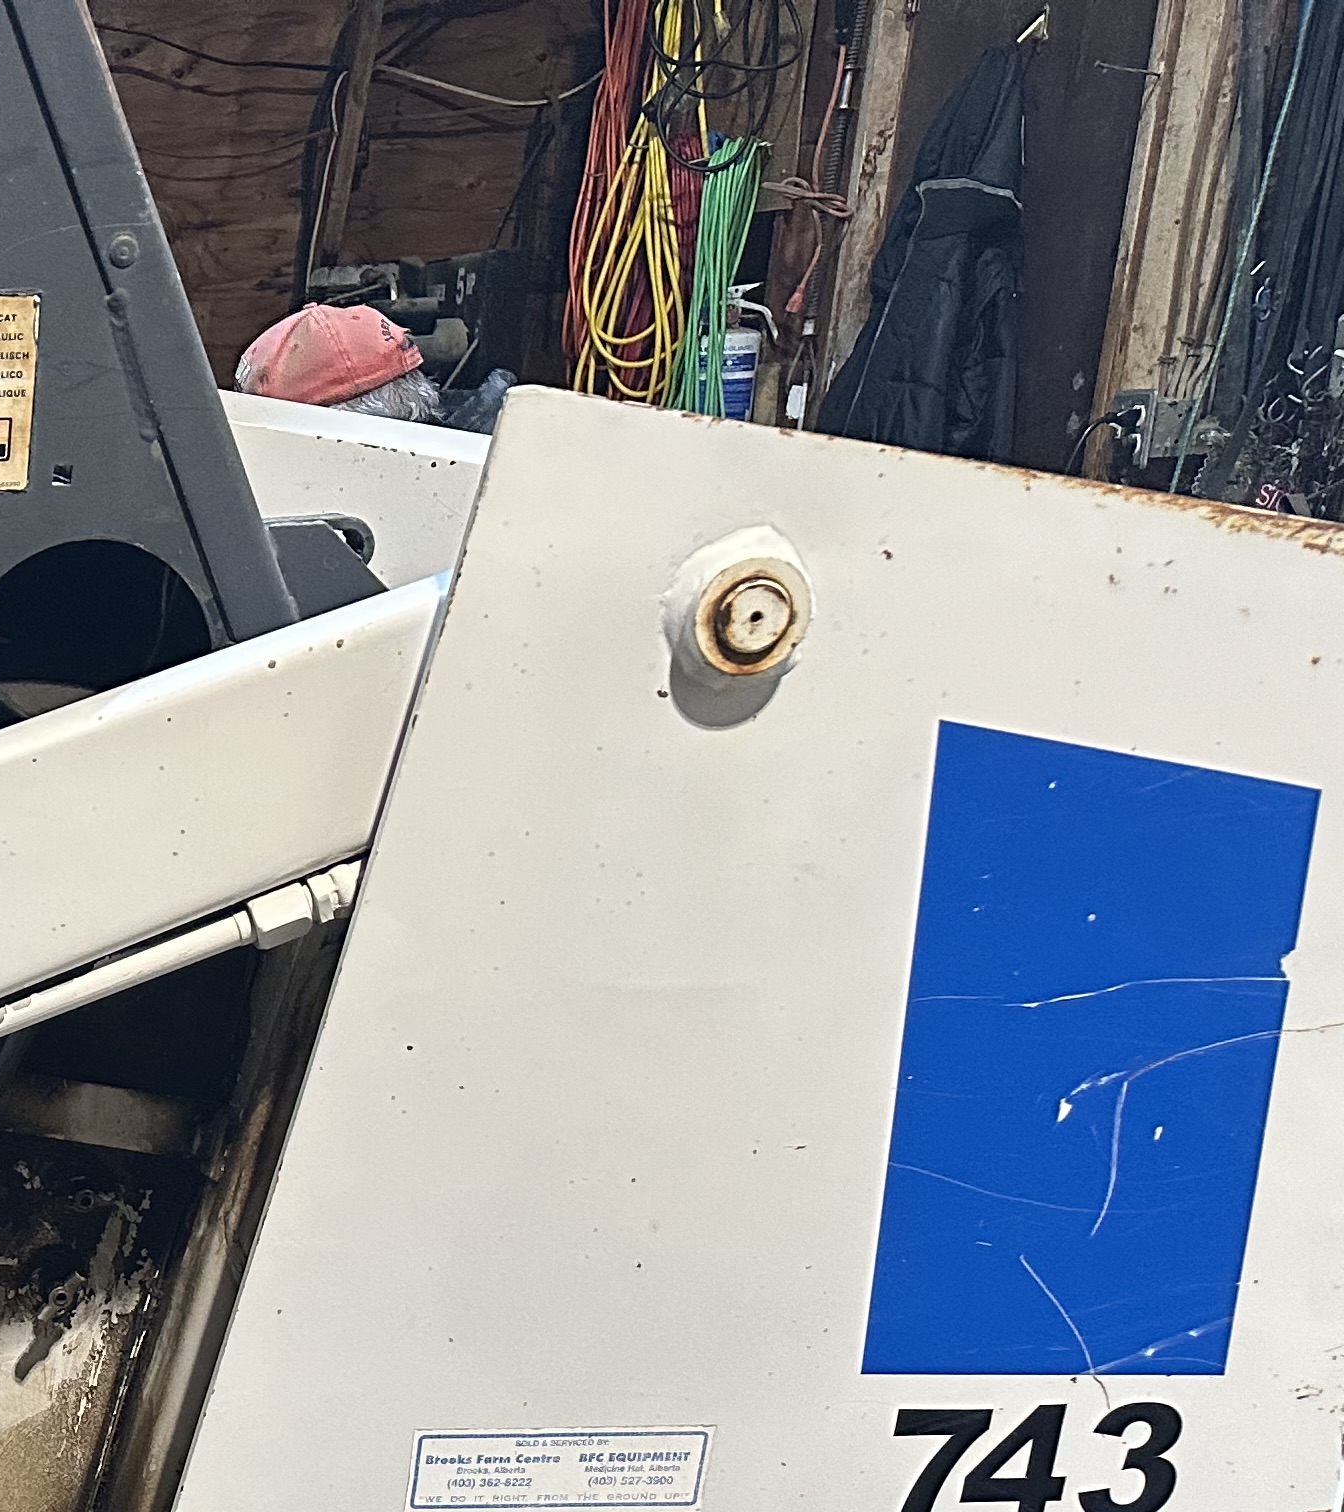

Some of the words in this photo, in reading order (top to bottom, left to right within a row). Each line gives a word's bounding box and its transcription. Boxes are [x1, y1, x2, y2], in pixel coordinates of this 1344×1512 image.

[425, 1455, 472, 1465] Brooks
[476, 1455, 510, 1464] Farm
[516, 1454, 561, 1463] Centre
[579, 1452, 603, 1462] BFC
[608, 1452, 690, 1462] EQUIPMENT
[493, 1466, 526, 1474] Alberta
[584, 1465, 625, 1474] Medicine
[649, 1464, 681, 1472] Alberta
[447, 1478, 476, 1489] (403)
[588, 1477, 617, 1487] (403)
[474, 1495, 485, 1503] IT
[577, 1493, 600, 1501] THE
[607, 1492, 657, 1500] GROUND
